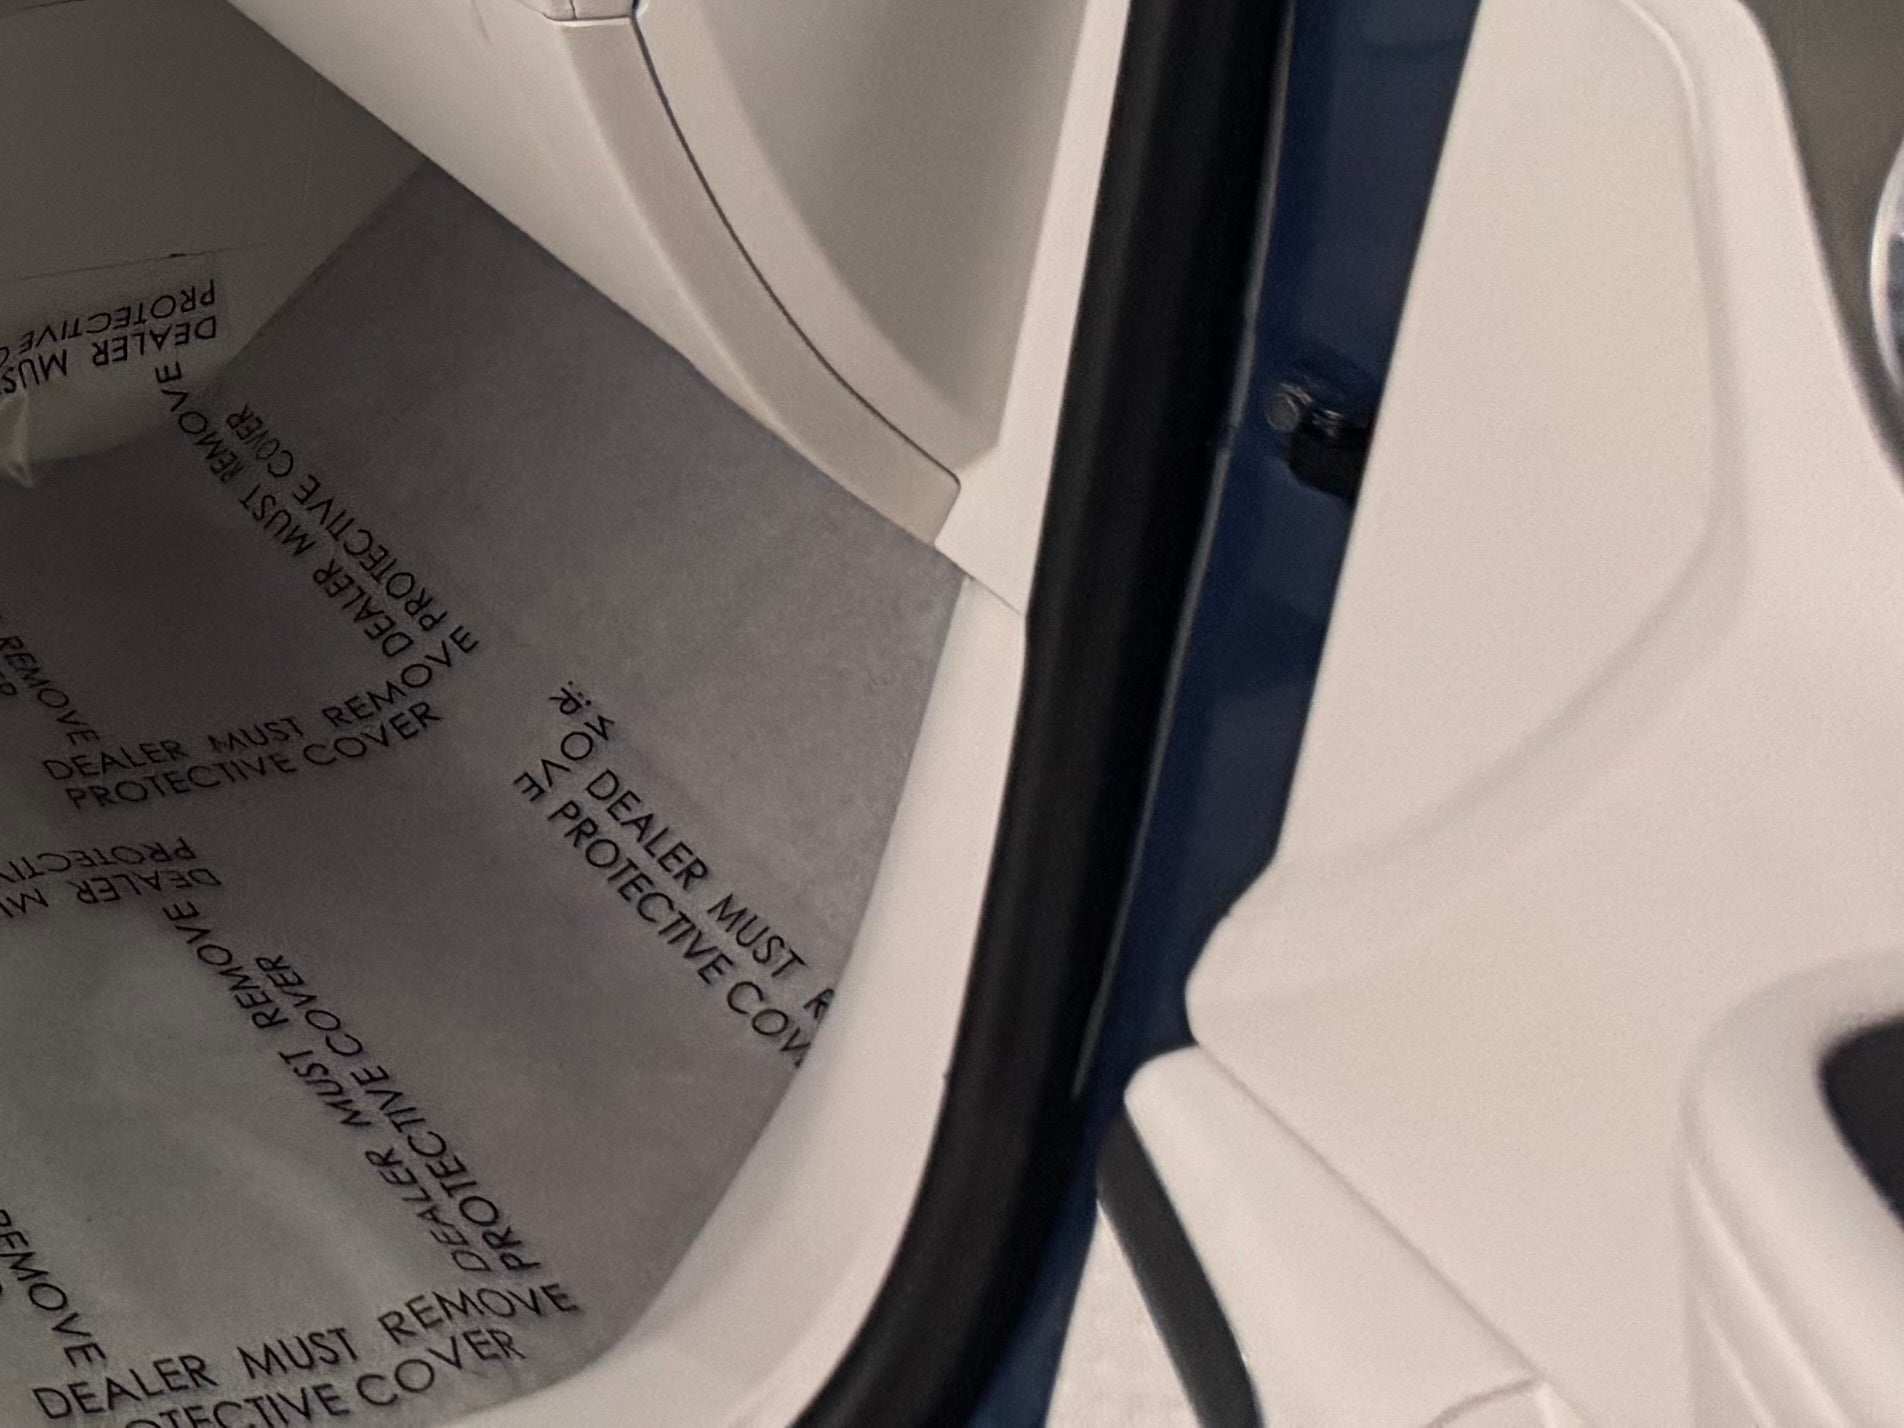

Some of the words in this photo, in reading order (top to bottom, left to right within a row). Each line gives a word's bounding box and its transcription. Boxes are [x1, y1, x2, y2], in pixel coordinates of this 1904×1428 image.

[20, 277, 217, 354] PROTECTIVE
[91, 314, 218, 367] DEALER
[238, 482, 318, 558] MUST
[292, 473, 448, 632] PROTECTIVE
[311, 557, 415, 658] DEALER
[41, 738, 191, 781] DEALER
[206, 715, 305, 755] MUST
[322, 624, 481, 730] REMOVE
[65, 750, 299, 810] PROTECTIVE
[303, 700, 445, 767] COVER
[65, 867, 223, 905] DEALER
[546, 799, 737, 988] PROTECTIVE
[584, 767, 710, 893] DEALER
[706, 892, 809, 979] MUST
[161, 899, 289, 1031] REMOVE
[254, 953, 365, 1058] COVER
[277, 1048, 373, 1130] MUST
[350, 1063, 541, 1272] PROTECTIVE
[363, 1146, 494, 1273] DEALER
[31, 1353, 221, 1420] DEALER
[235, 1325, 362, 1382] MUST
[377, 1281, 581, 1349] REMOVE
[355, 1327, 529, 1408] COVER
